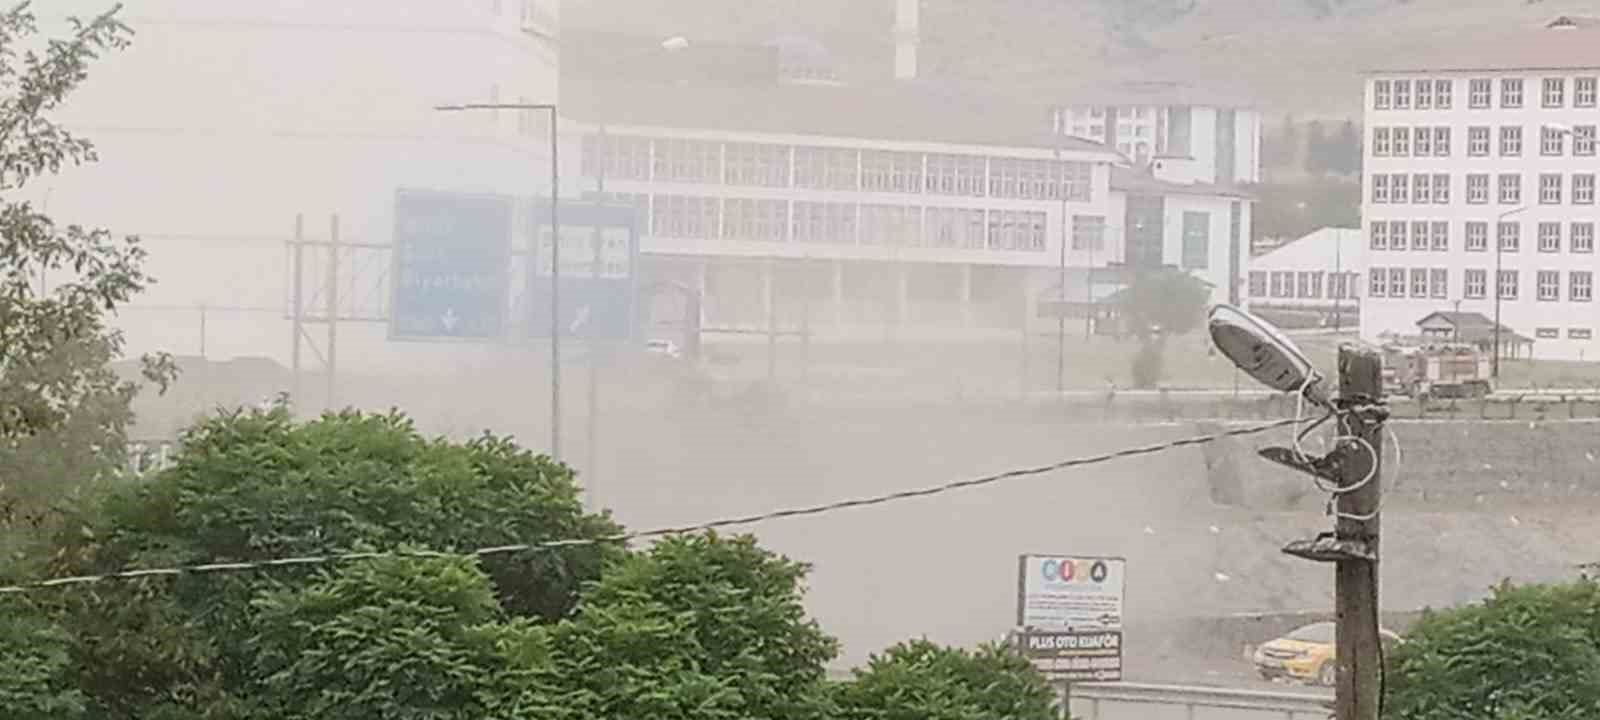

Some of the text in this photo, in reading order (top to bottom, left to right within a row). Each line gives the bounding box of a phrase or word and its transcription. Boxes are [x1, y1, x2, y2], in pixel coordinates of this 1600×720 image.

[1029, 633, 1119, 649] PLUS OTO KUAFÖR
